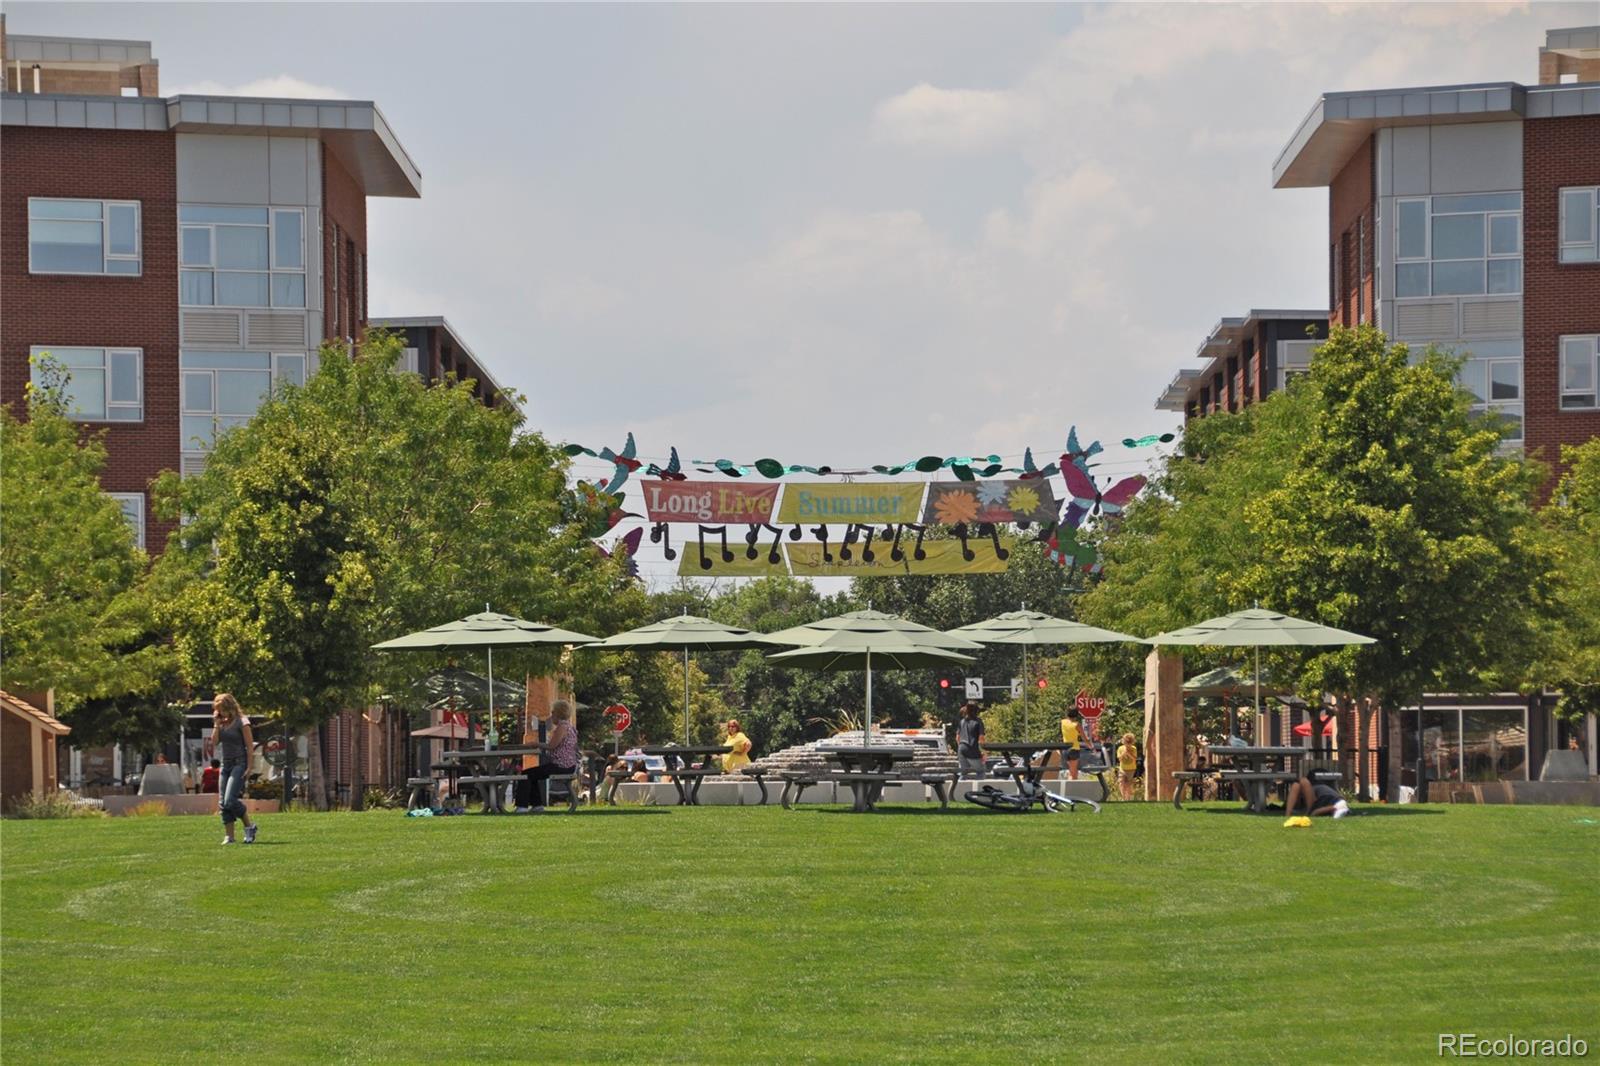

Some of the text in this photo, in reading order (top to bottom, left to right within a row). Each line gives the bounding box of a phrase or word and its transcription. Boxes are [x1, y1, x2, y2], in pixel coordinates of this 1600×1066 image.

[650, 487, 903, 519] Long Live Summer
[1078, 697, 1104, 709] STOP
